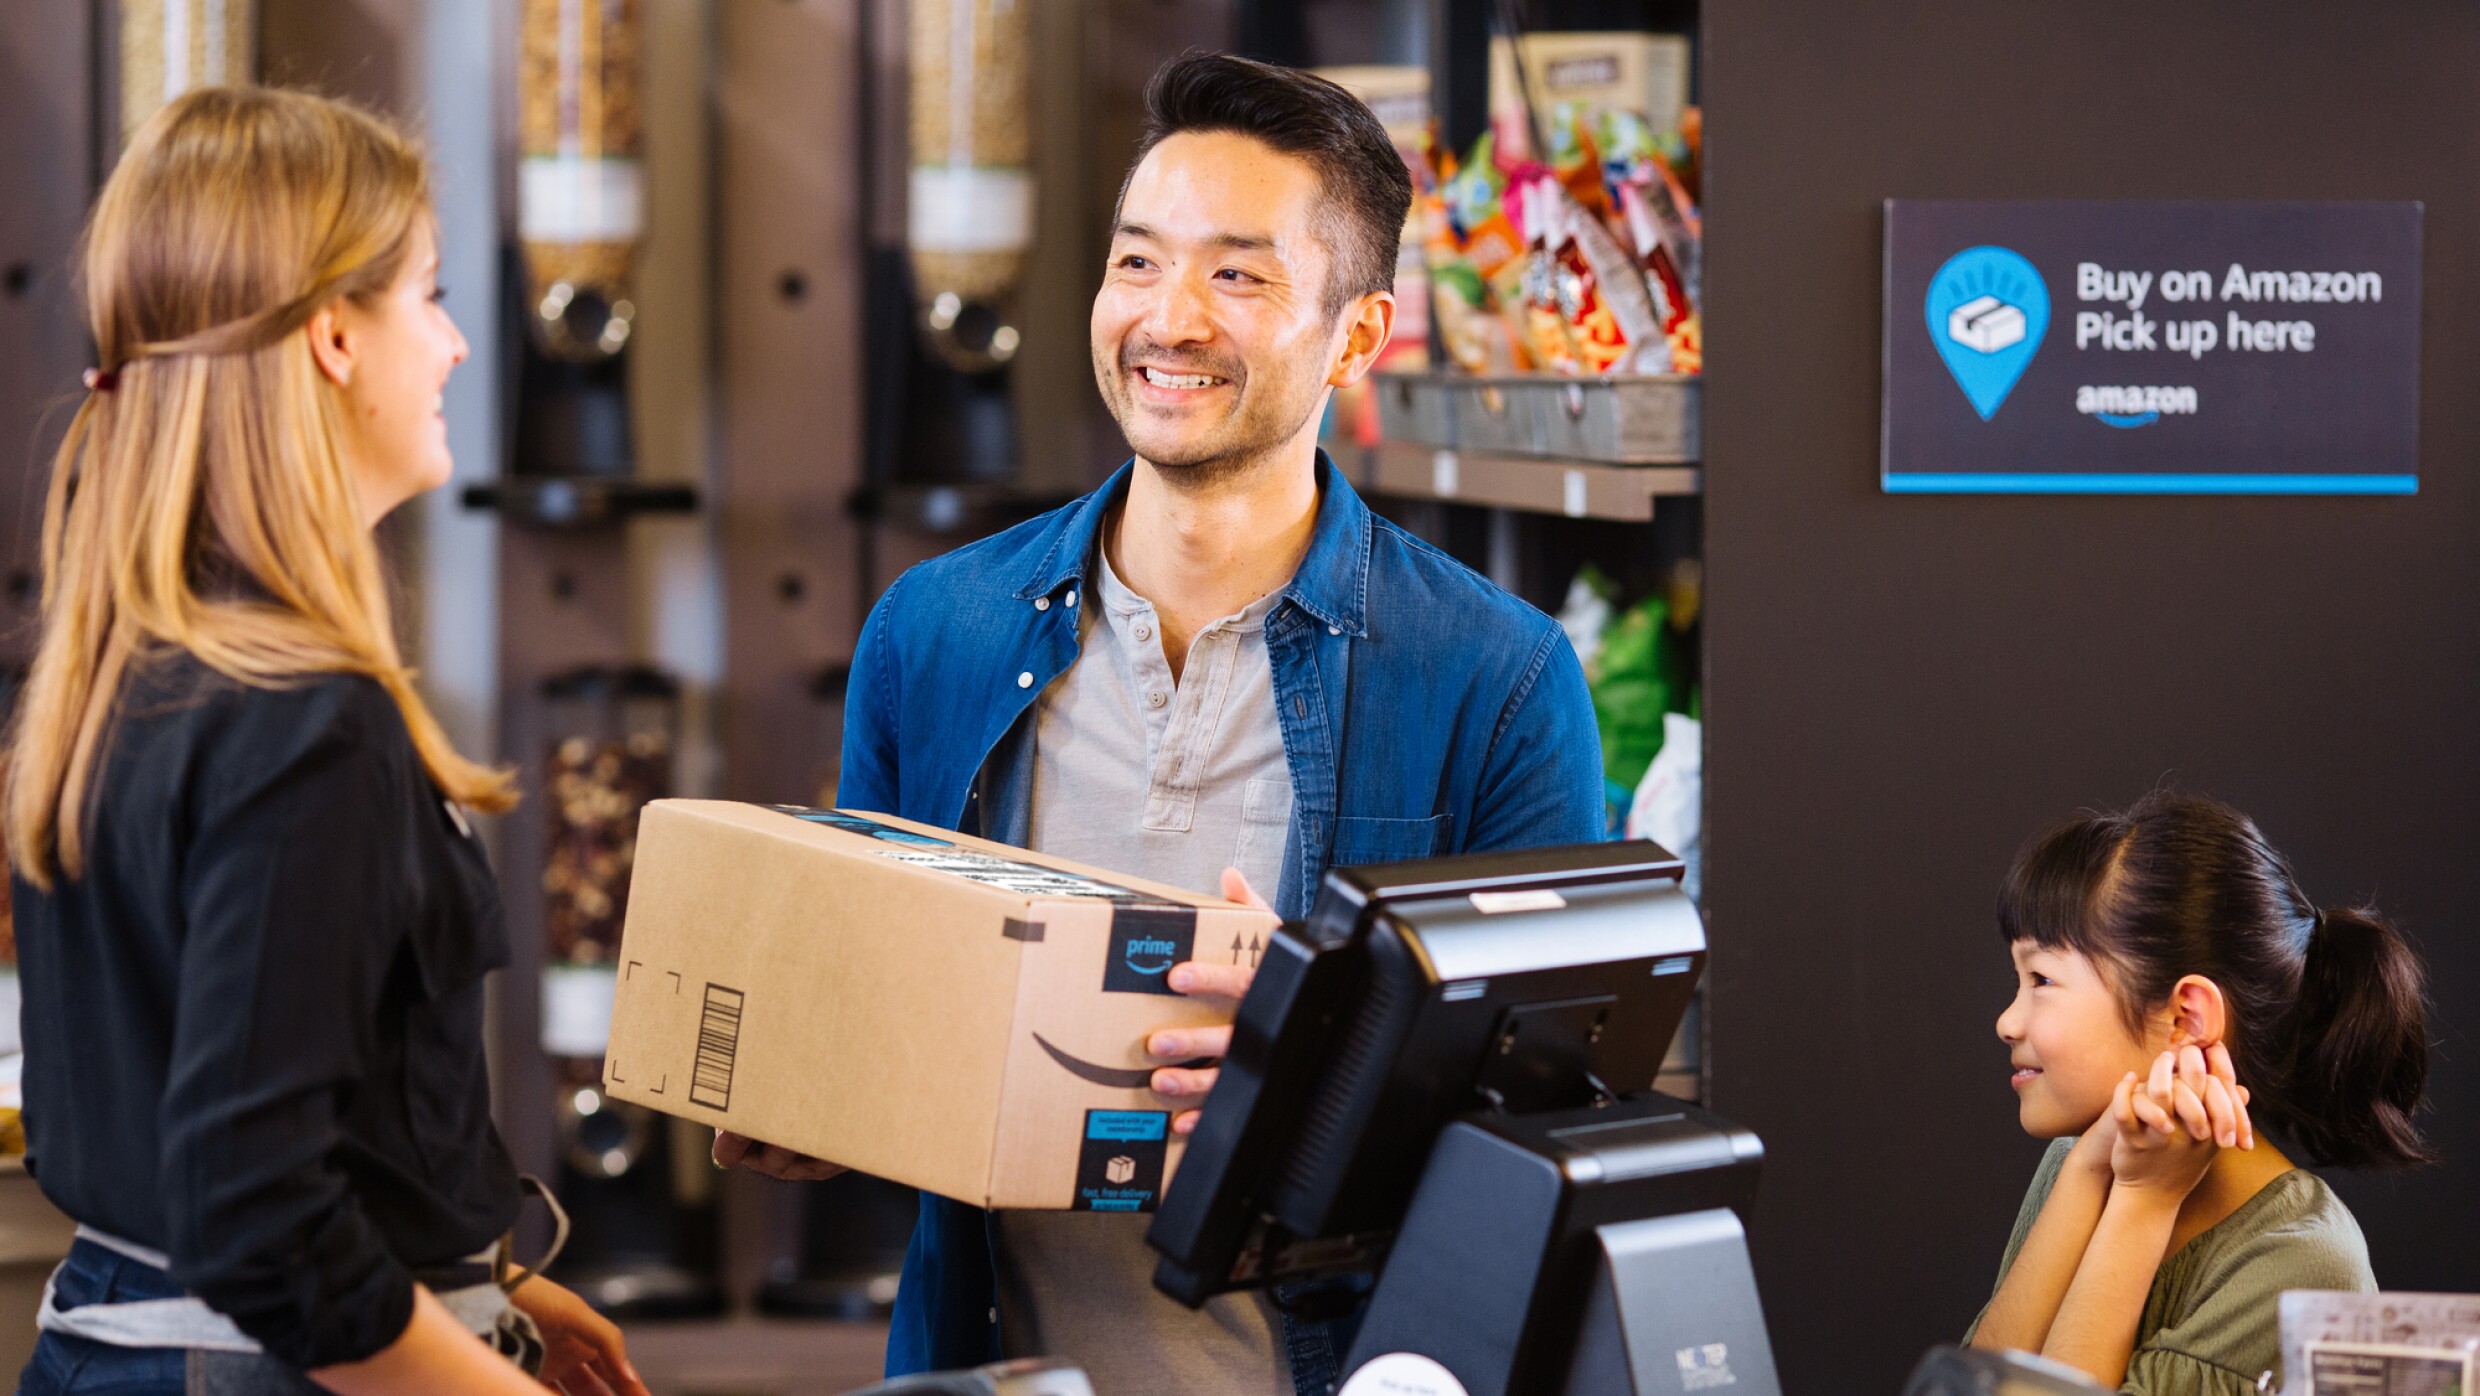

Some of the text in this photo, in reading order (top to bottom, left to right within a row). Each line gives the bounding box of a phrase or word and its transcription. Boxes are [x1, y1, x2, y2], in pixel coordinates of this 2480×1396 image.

[2076, 262, 2382, 312] Buy on Amazon
[2076, 310, 2316, 360] Pick up here
[2075, 384, 2198, 415] amazon
[1126, 935, 1176, 959] prime
[1119, 1188, 1153, 1201] delivery
